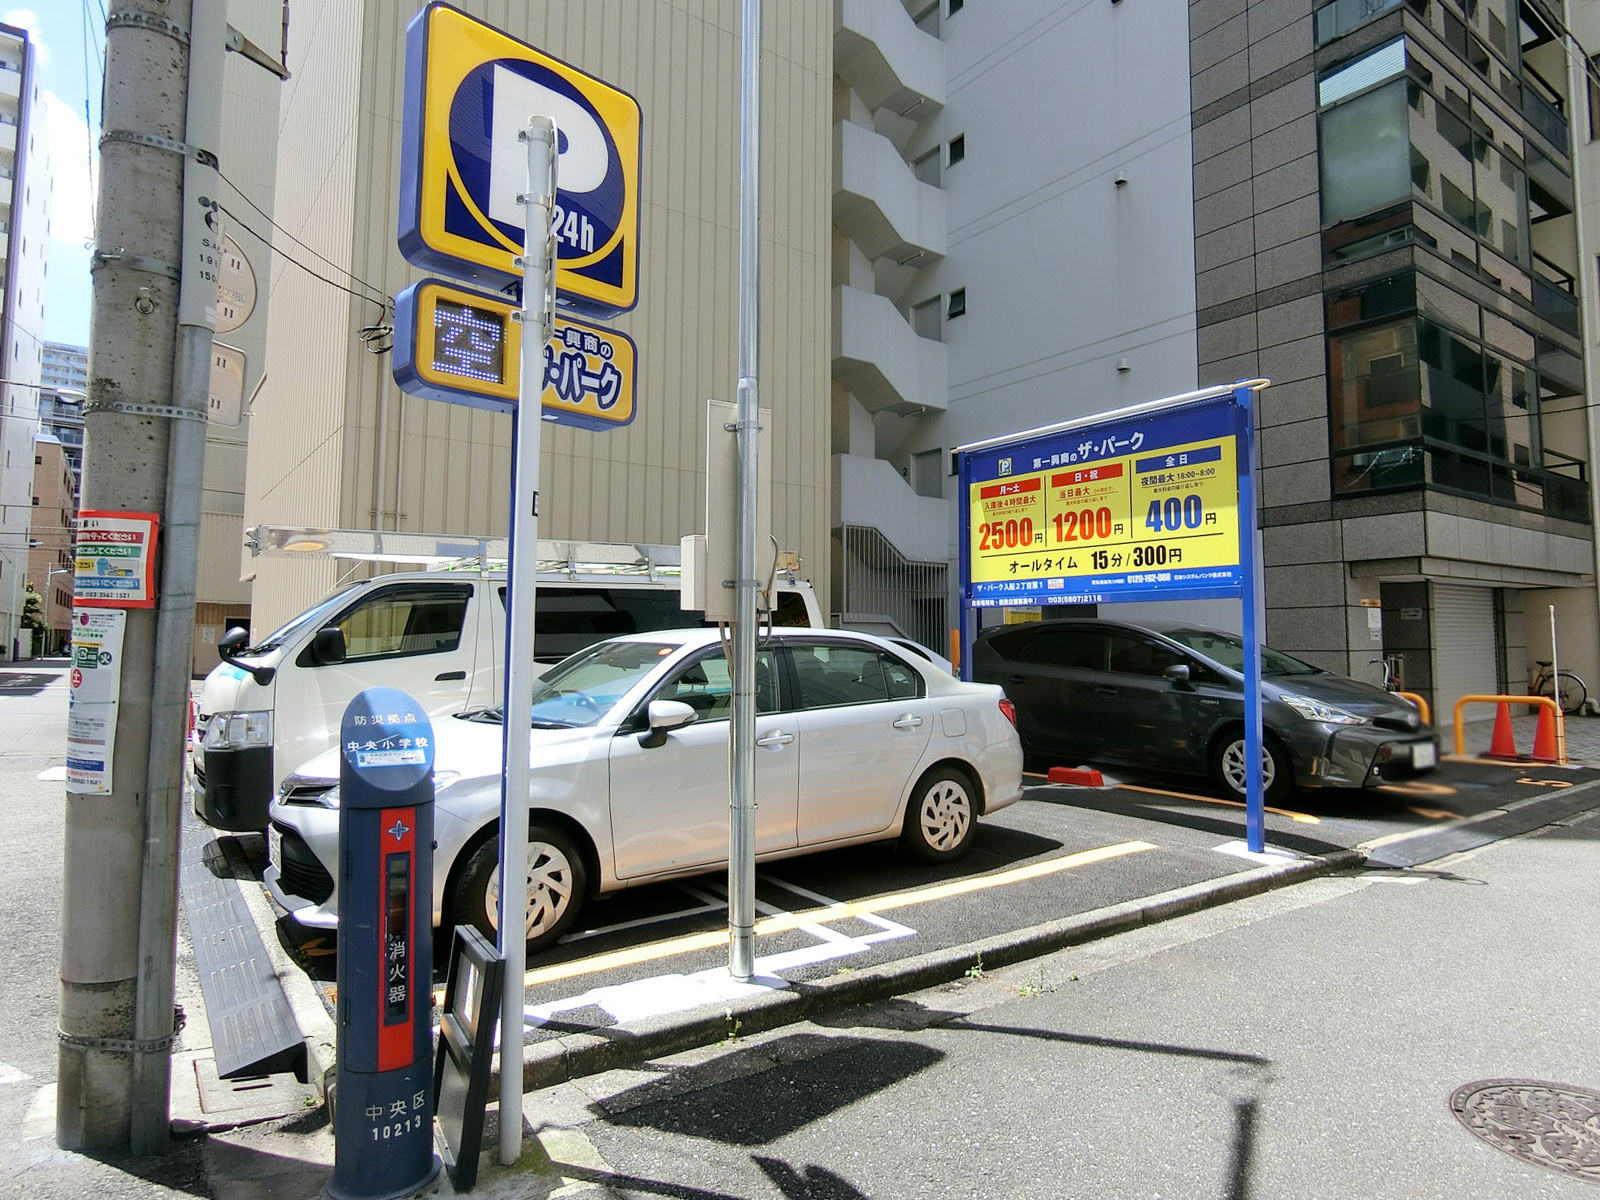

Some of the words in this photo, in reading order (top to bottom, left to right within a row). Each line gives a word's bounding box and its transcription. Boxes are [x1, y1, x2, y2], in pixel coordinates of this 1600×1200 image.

[489, 64, 608, 232] P
[551, 204, 595, 253] 24h
[433, 307, 500, 382] 空
[1165, 453, 1188, 467] 全日
[1075, 469, 1099, 482] 日・祝
[1141, 473, 1175, 486] 夜間最大
[1060, 486, 1090, 499] 当日最大
[1009, 556, 1078, 574] オールタイム
[354, 712, 417, 726] 防災拠点
[347, 736, 429, 752] 中央小学校
[388, 941, 407, 1004] 消火器
[365, 1090, 426, 1122] 中央区
[372, 1114, 422, 1141] 10213
